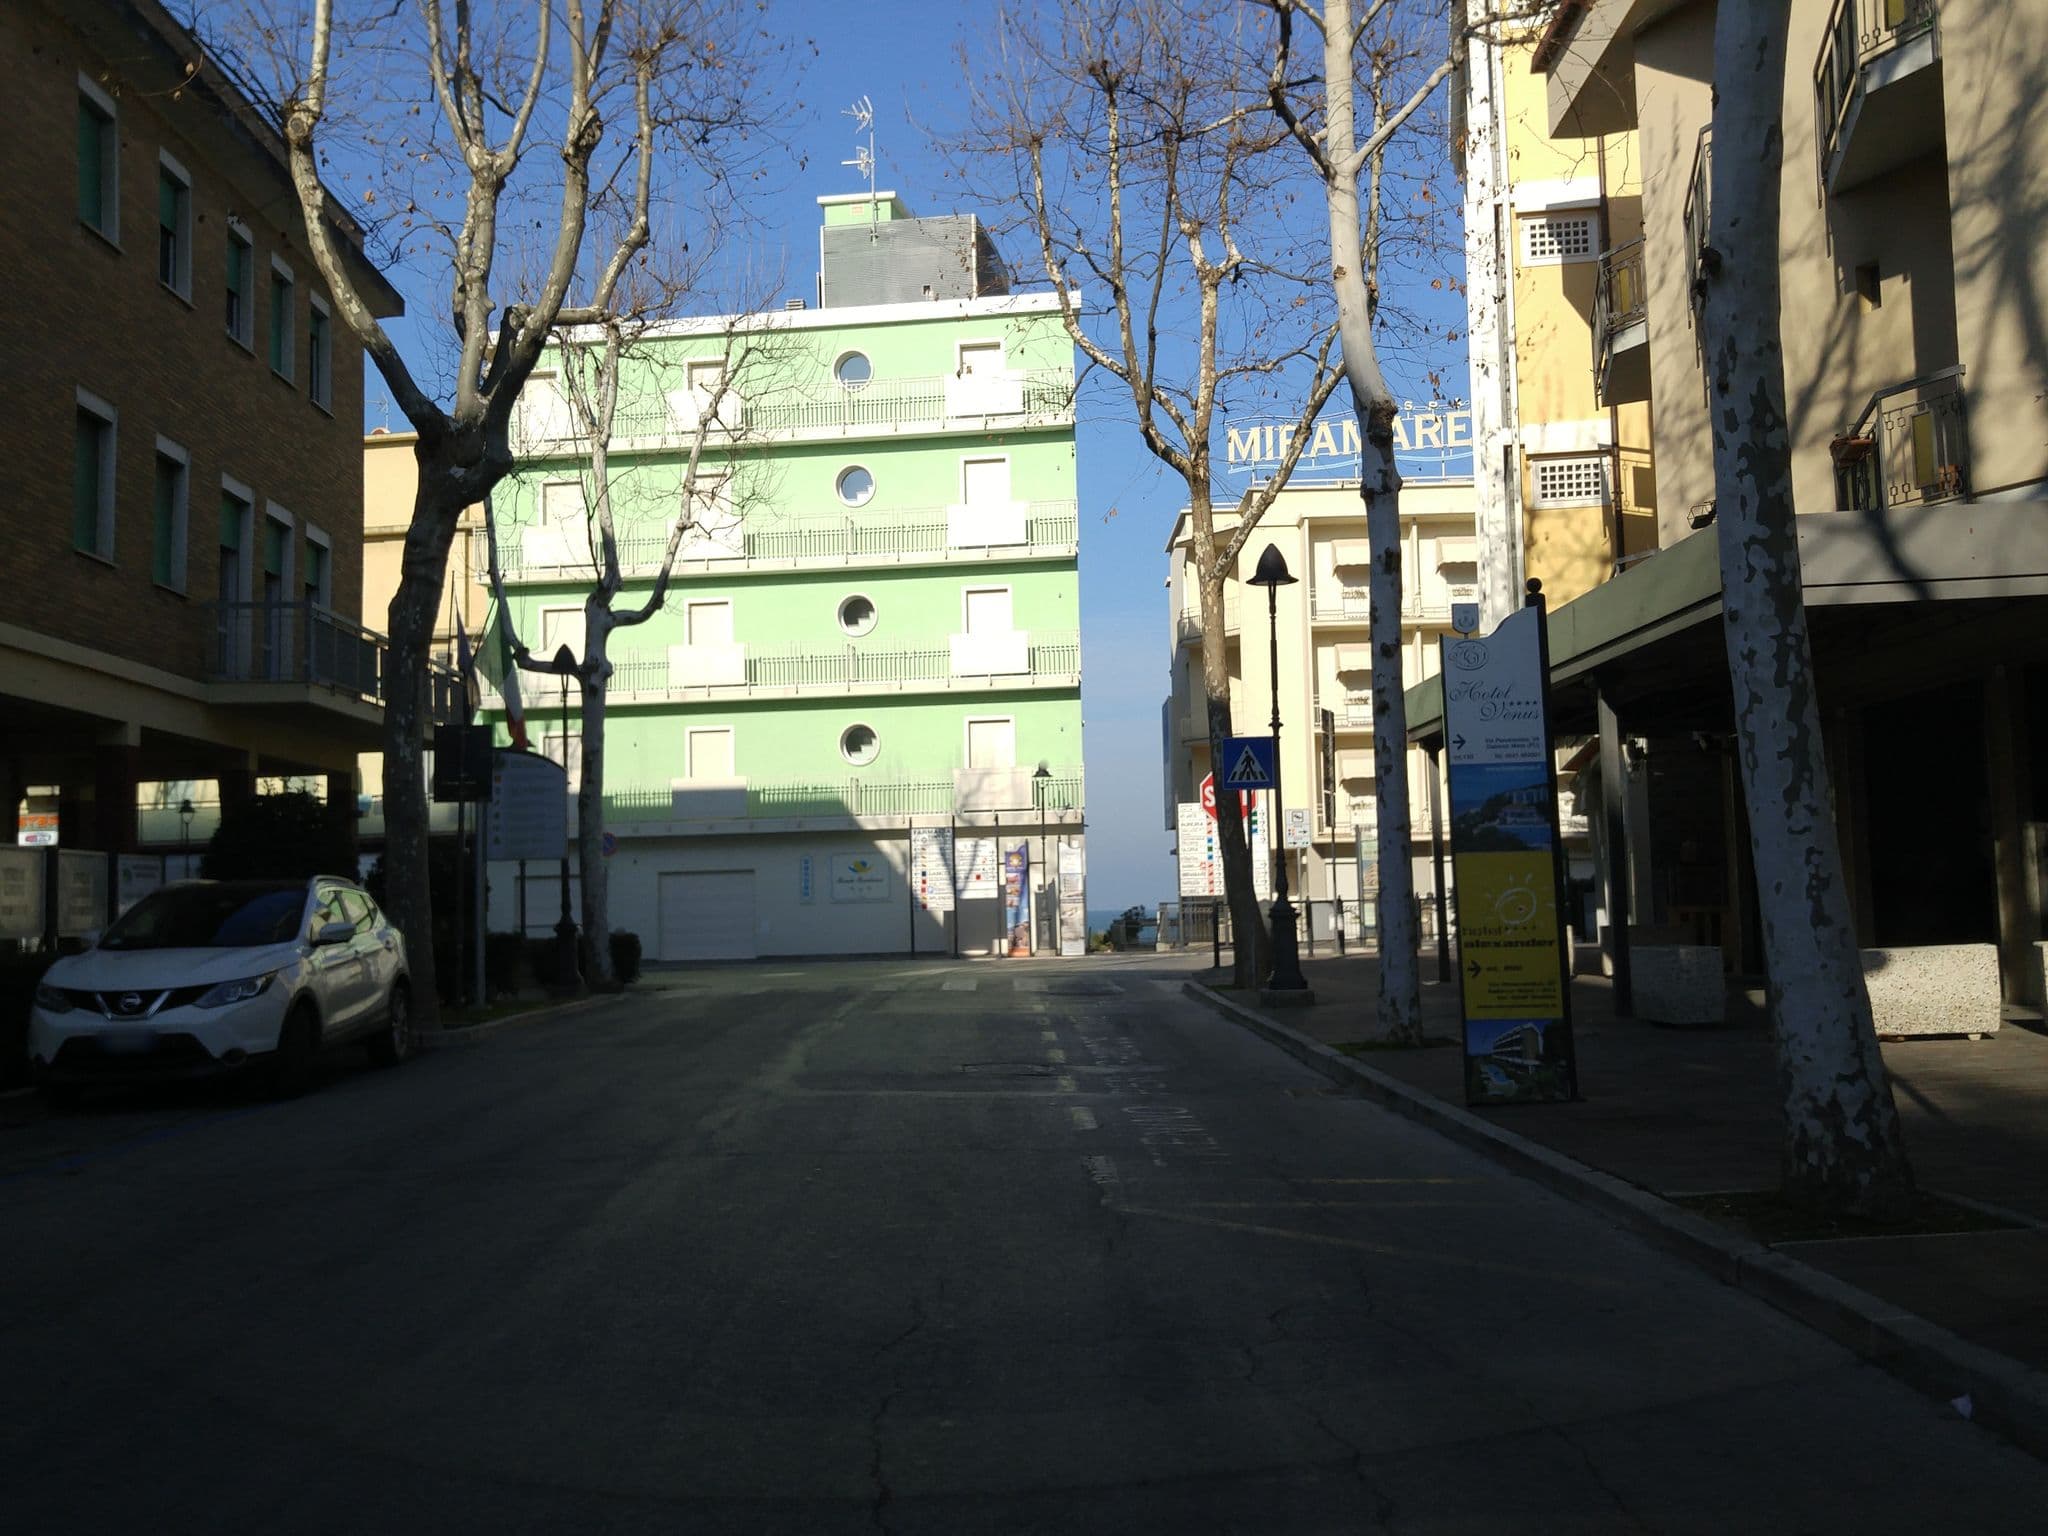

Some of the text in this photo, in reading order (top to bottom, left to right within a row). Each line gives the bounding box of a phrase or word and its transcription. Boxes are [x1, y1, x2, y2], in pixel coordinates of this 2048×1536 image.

[1228, 411, 1473, 463] MIRAMARE
[1449, 680, 1513, 702] Hotel
[1480, 701, 1540, 722] Venus
[1462, 926, 1502, 936] hotel
[1464, 938, 1554, 948] alexander
